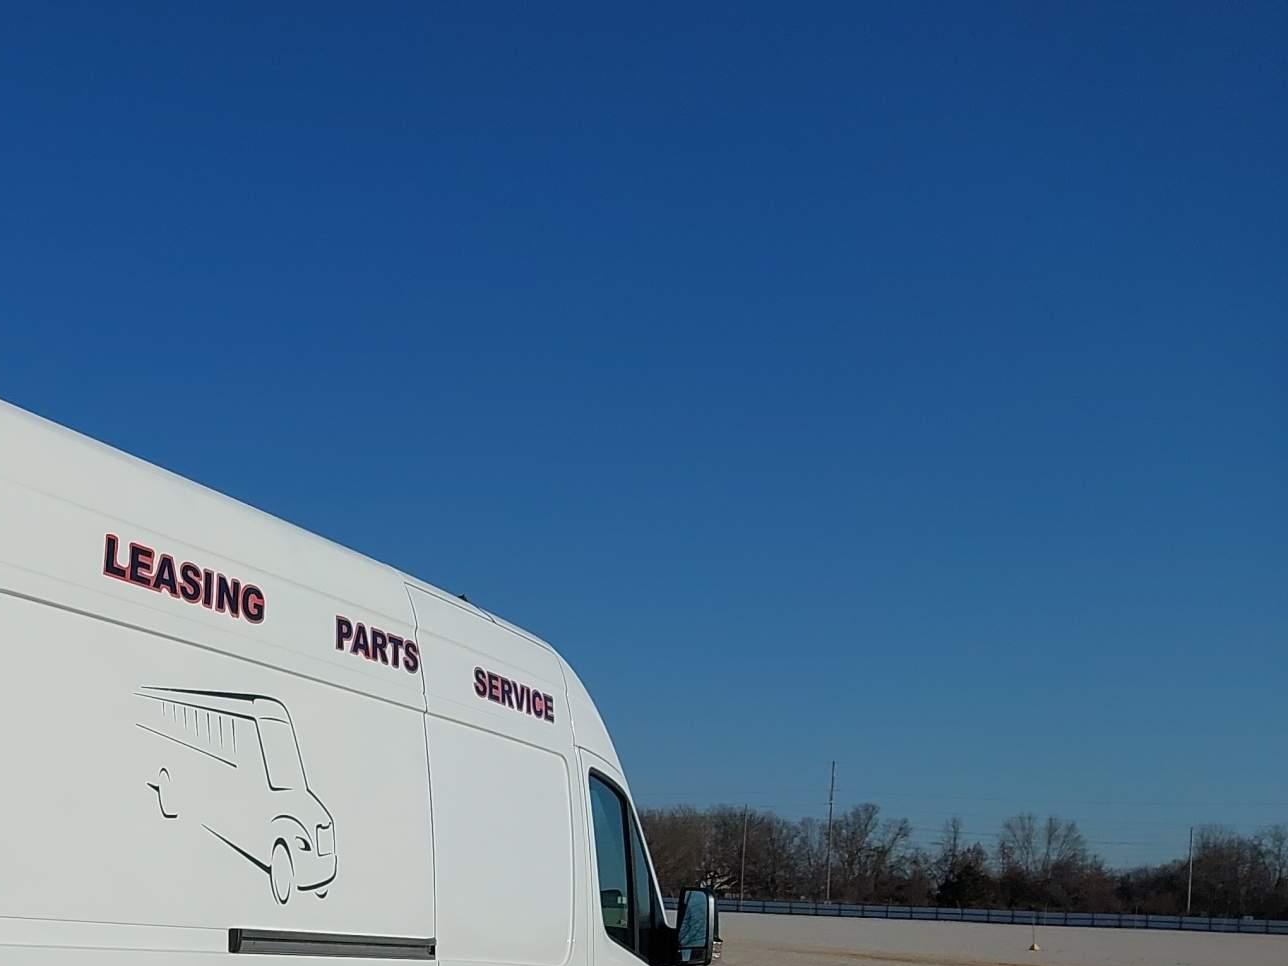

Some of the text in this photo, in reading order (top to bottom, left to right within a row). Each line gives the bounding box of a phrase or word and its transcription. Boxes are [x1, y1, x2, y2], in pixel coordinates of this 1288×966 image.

[103, 532, 266, 624] LEASING
[335, 614, 420, 674] PARTS
[473, 667, 556, 722] SERVICE
